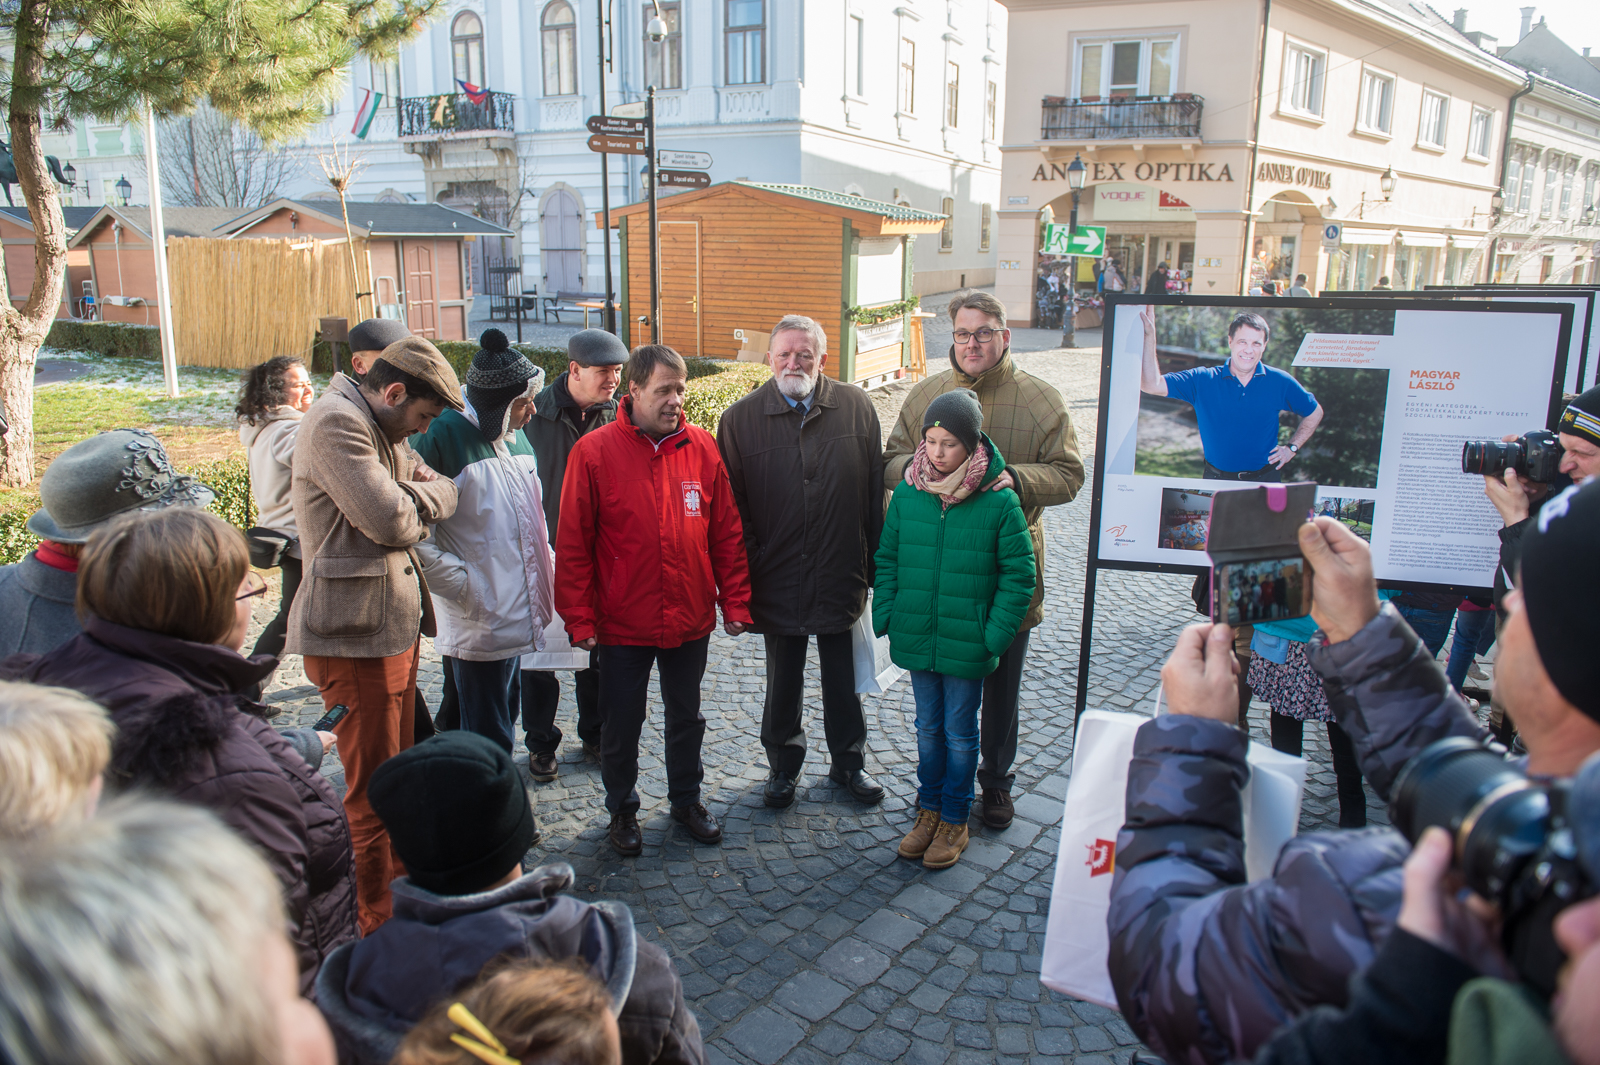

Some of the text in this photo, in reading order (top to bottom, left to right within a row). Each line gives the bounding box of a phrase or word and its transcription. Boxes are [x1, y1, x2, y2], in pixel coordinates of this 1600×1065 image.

[1032, 162, 1235, 182] ANEX OPTIKA
[1100, 191, 1146, 202] VOGUE
[1410, 370, 1460, 380] MAGYAR
[1409, 380, 1455, 390] LÁSZLÓ
